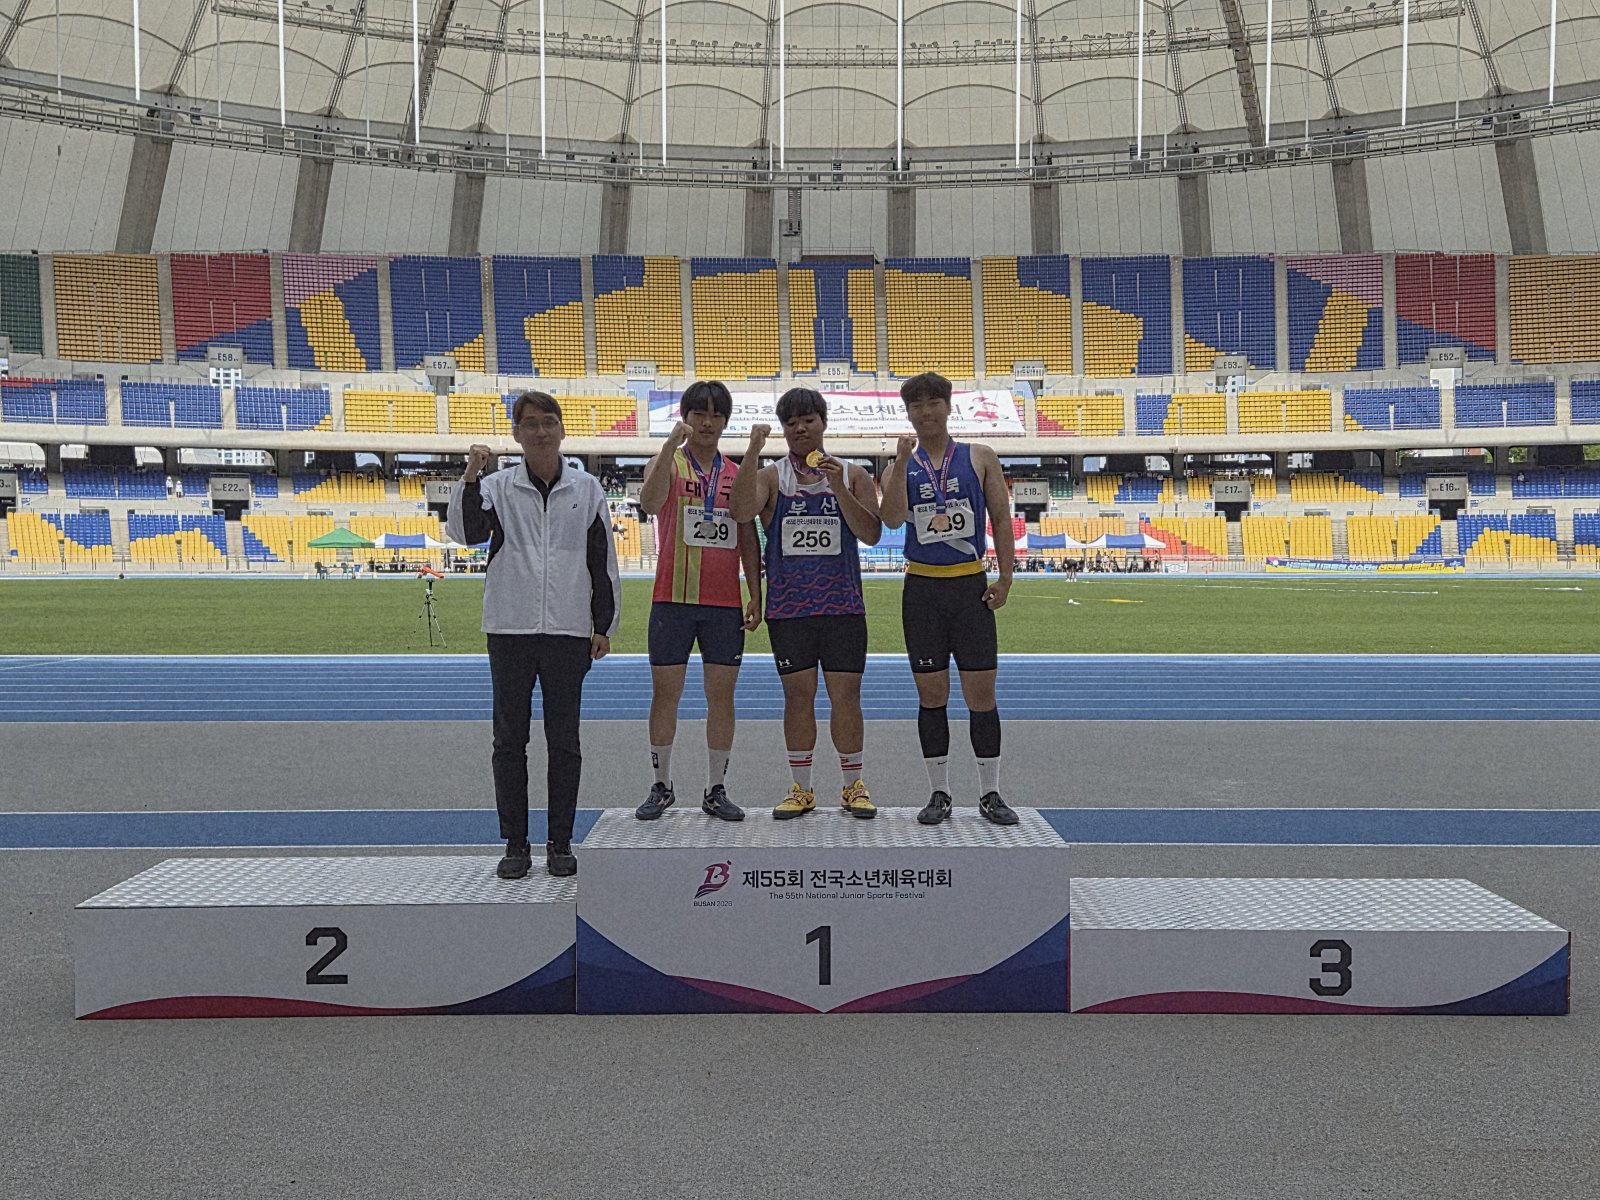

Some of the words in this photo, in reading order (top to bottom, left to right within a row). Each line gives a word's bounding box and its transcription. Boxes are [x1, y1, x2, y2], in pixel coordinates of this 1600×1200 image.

[217, 352, 233, 362] E58
[1439, 352, 1454, 361] E52
[432, 361, 447, 369] E57
[1223, 361, 1238, 369] E53
[827, 367, 841, 376] E55
[222, 483, 239, 492] E22
[438, 486, 452, 494] E21
[1023, 487, 1037, 496] E18
[1224, 486, 1238, 494] E17
[1439, 482, 1454, 492] E16
[792, 530, 832, 548] 256
[742, 869, 804, 889] 제55회
[810, 869, 952, 889] 전국소년체육대회
[867, 892, 893, 900] Sports
[305, 927, 348, 985] 2
[805, 925, 832, 986] 1
[1309, 939, 1352, 997] 3
